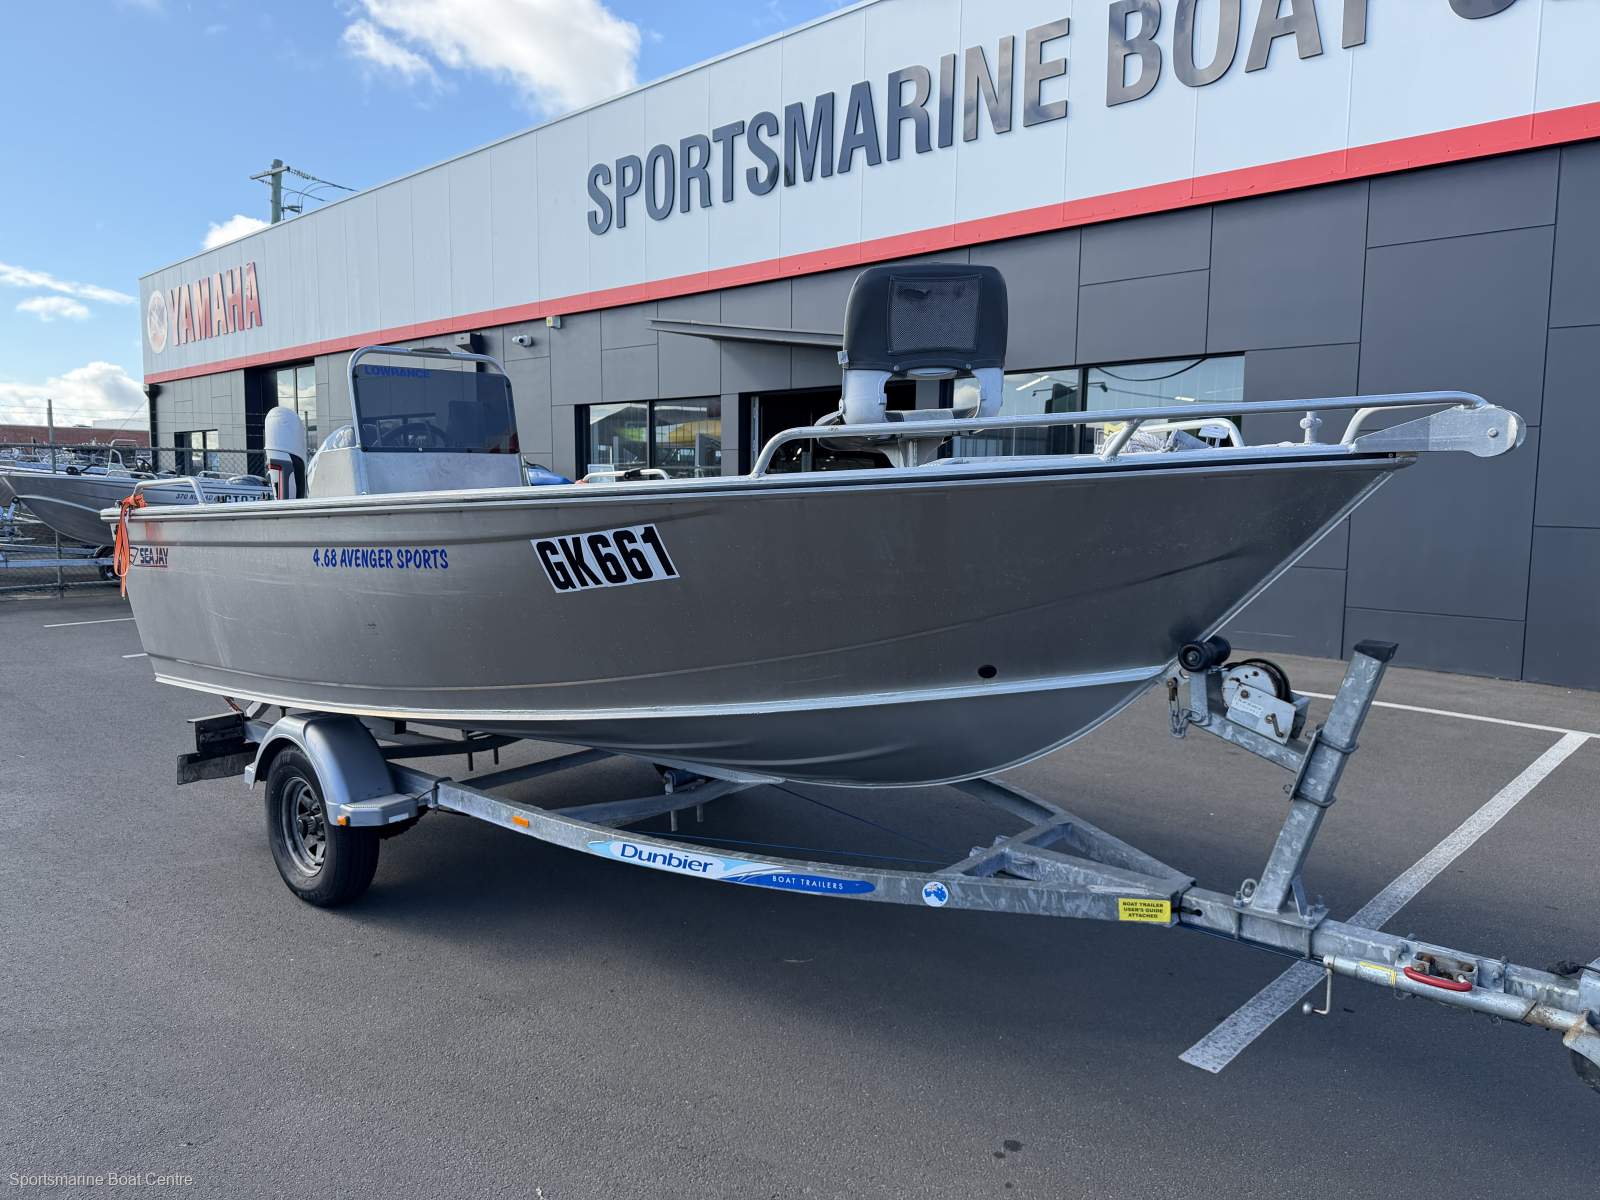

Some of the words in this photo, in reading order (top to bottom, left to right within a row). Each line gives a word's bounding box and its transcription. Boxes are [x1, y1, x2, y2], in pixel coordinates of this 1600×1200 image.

[587, 17, 1070, 236] SPORTSMARINE
[167, 262, 263, 346] YAMAHA
[313, 548, 337, 567] 4.68
[340, 548, 394, 568] AVENGER
[397, 549, 449, 569] SPORTS
[536, 526, 676, 590] GK661
[620, 843, 713, 873] Dunbier
[772, 875, 796, 884] BOAT
[801, 878, 844, 890] TRAILERS
